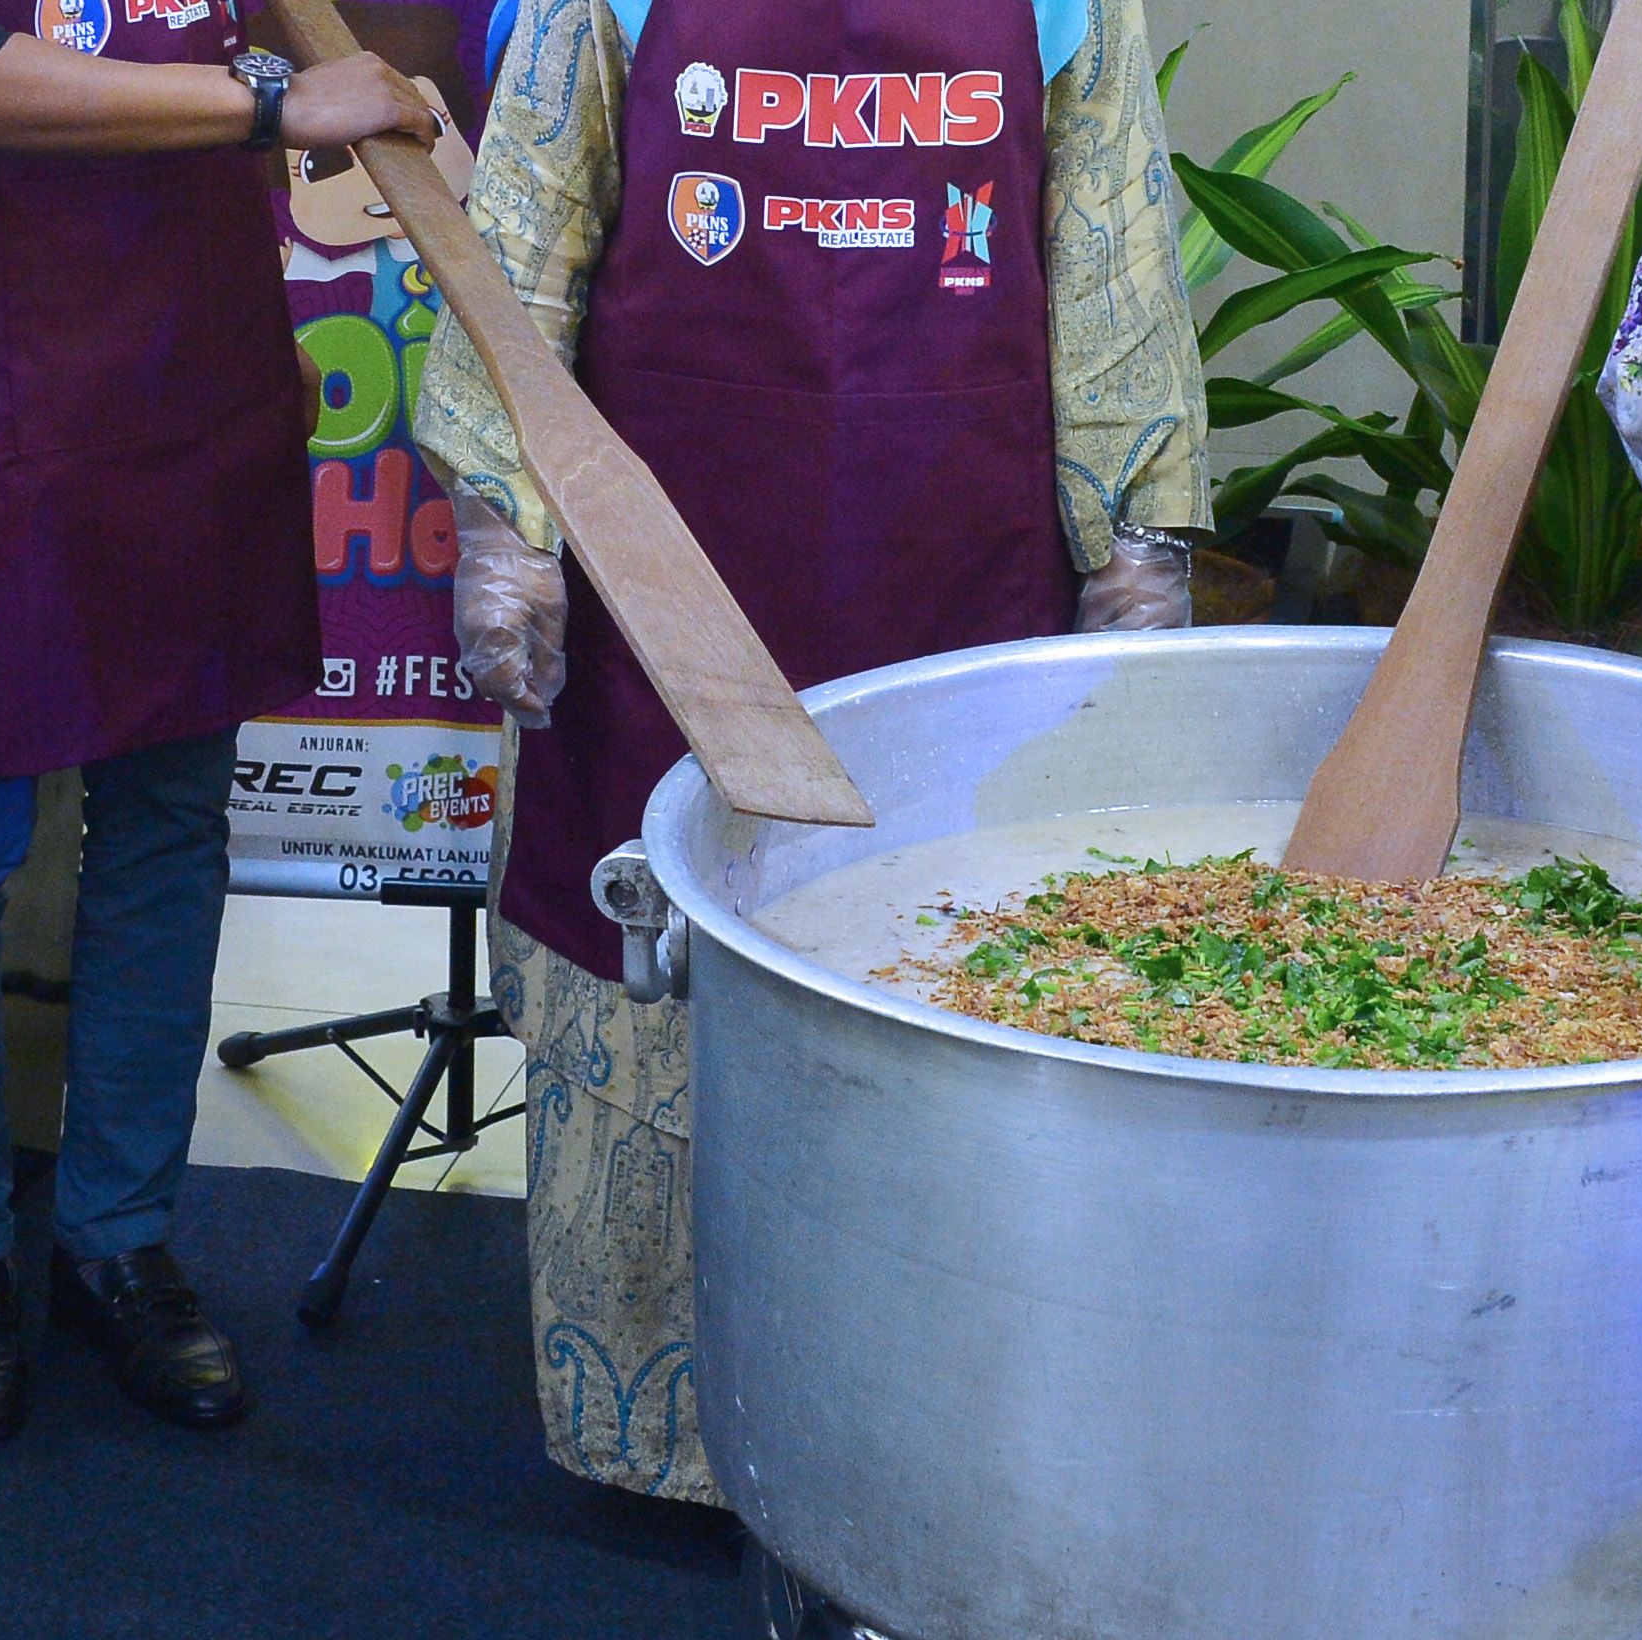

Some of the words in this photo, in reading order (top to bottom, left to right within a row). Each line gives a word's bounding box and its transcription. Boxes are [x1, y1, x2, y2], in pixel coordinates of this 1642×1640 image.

[53, 21, 94, 39] PKNS
[76, 35, 97, 50] FC
[733, 68, 1004, 148] PKNS
[686, 212, 729, 231] PKNS
[764, 196, 915, 231] PKNS
[708, 230, 729, 246] FC
[820, 230, 857, 247] REAL
[859, 231, 914, 246] ESTATE
[376, 656, 473, 700] #FES
[299, 737, 369, 753] ANJURAN:
[402, 771, 463, 807] PREC
[287, 802, 362, 817] ESTATE
[281, 841, 334, 857] UNTUK
[339, 843, 433, 861] MAKLUMAT
[338, 863, 378, 891] 03
